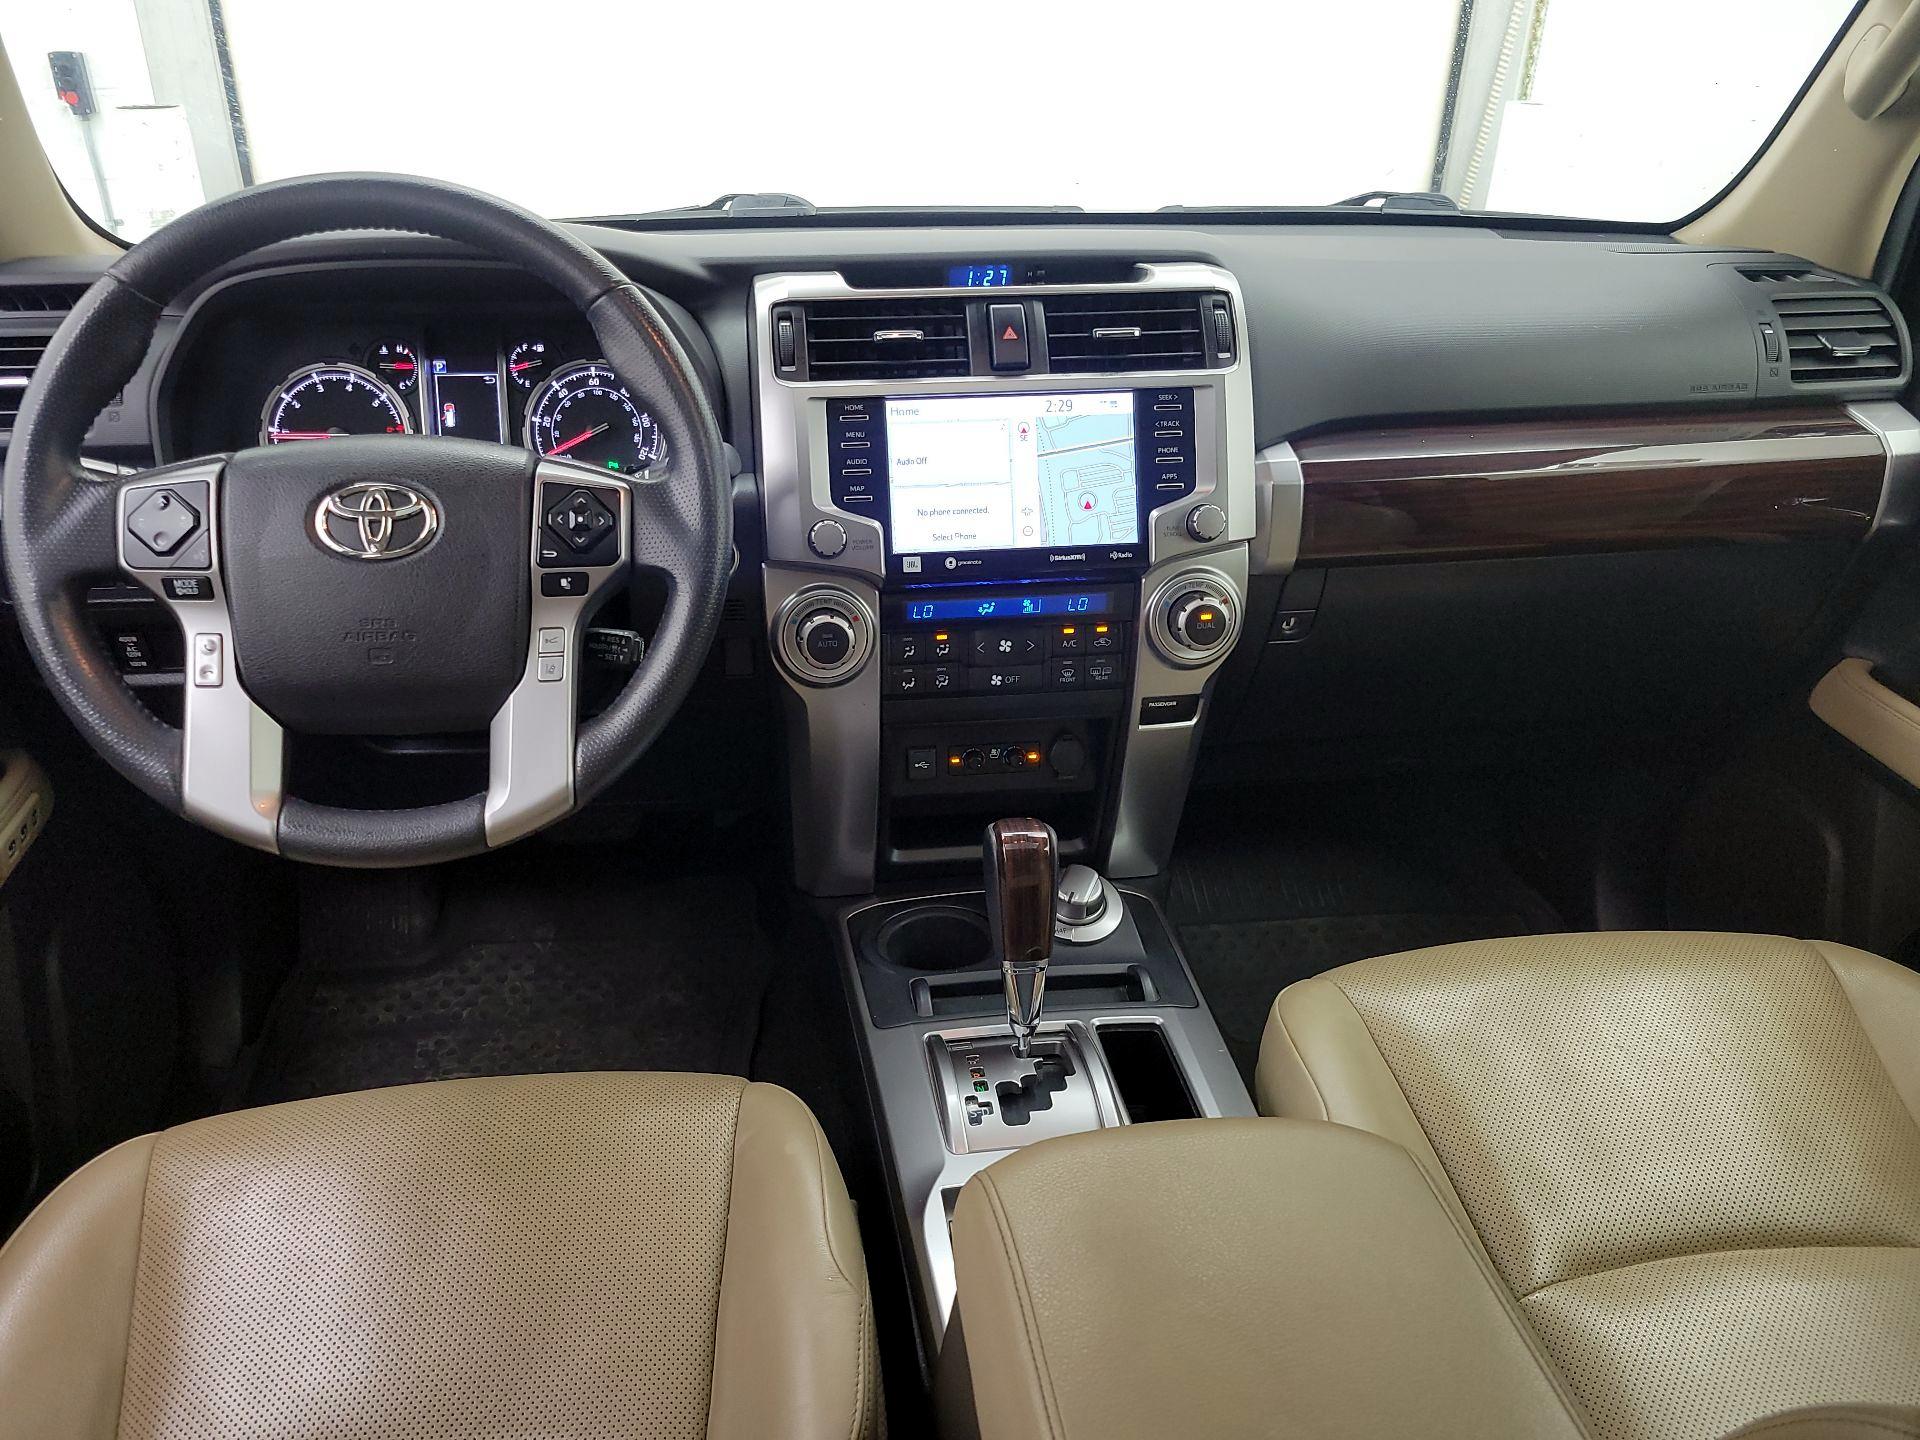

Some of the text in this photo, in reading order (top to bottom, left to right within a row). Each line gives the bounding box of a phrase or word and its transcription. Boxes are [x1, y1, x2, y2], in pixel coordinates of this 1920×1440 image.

[967, 270, 1007, 287] 1:27
[396, 345, 403, 353] H
[588, 377, 600, 386] 60
[316, 385, 325, 393] 3
[344, 384, 353, 392] 4
[557, 389, 569, 399] 40
[292, 401, 301, 409] 2
[372, 399, 381, 408] 5
[1046, 399, 1073, 413] 2:29
[890, 407, 920, 416] Home
[542, 416, 551, 428] 20
[640, 412, 651, 428] 100
[638, 446, 649, 461] 120
[896, 456, 928, 466] Audio Off
[917, 506, 990, 517] No phone connected.
[932, 532, 977, 541] Select Phone
[957, 559, 982, 567] gracenote
[173, 579, 200, 588] MODE
[1067, 597, 1089, 612] LO
[912, 604, 934, 619] LO
[343, 630, 417, 642] AIRBAG
[817, 640, 838, 648] AUTO
[1062, 640, 1077, 648] A/C
[1004, 675, 1021, 684] OFF
